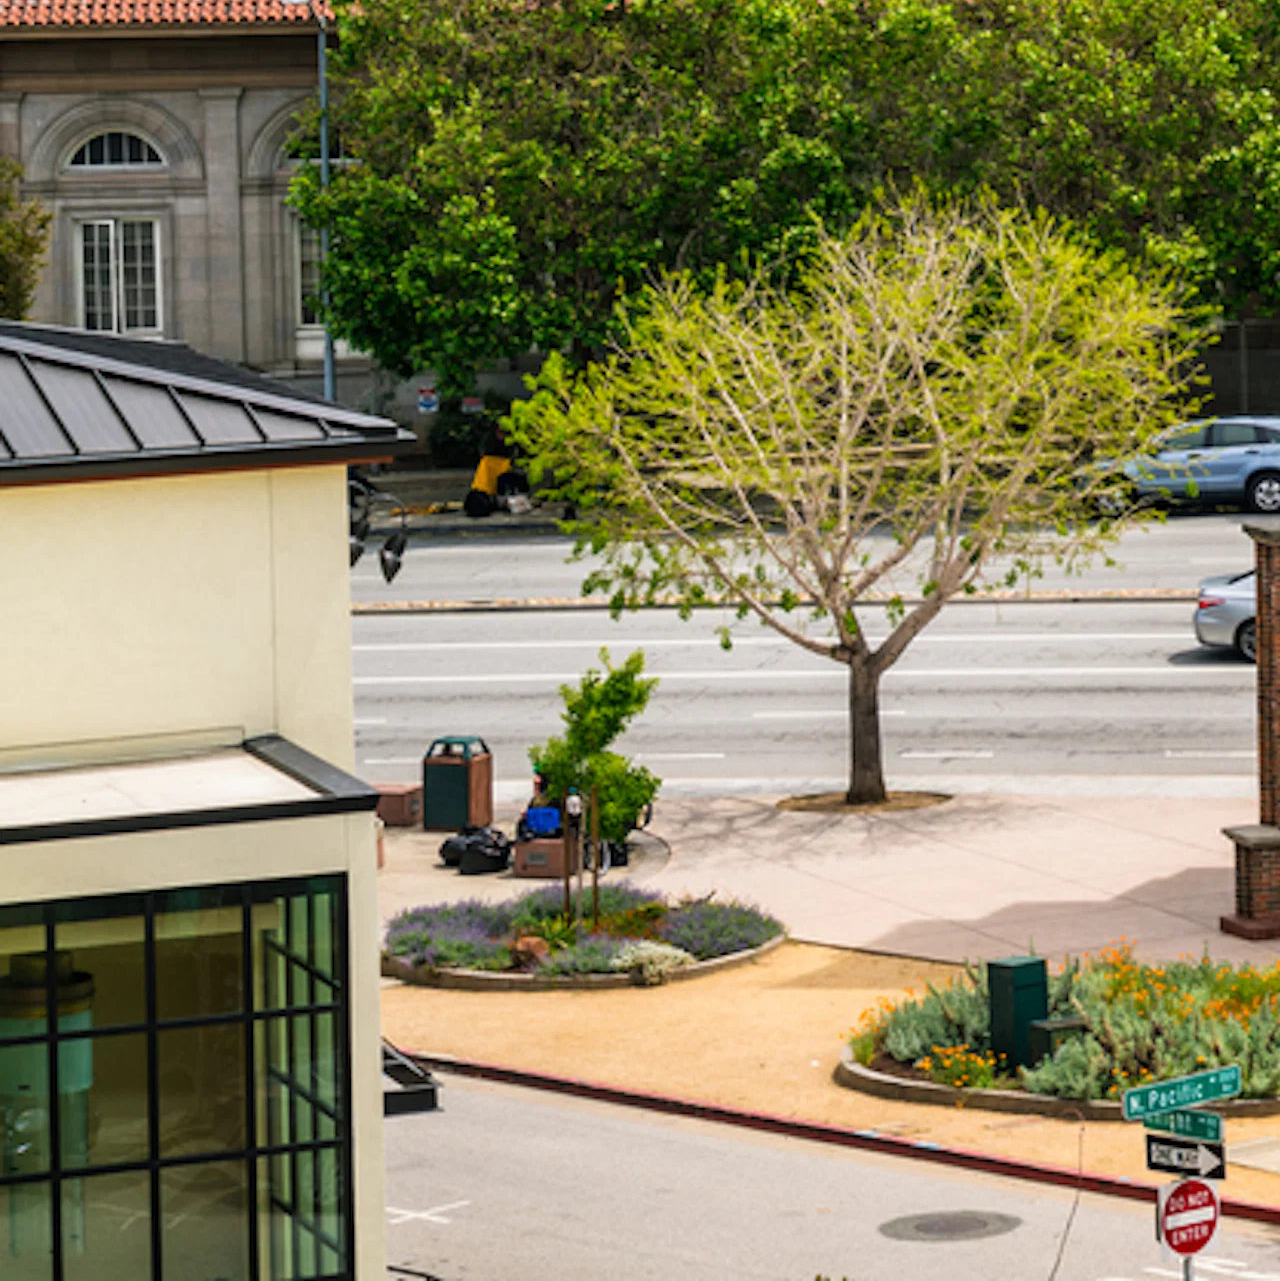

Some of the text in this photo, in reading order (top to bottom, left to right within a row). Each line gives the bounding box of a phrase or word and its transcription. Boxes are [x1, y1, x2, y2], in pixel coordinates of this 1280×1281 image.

[1148, 1081, 1204, 1111] Pacific
[1169, 1190, 1209, 1213] DO NOT
[1171, 1224, 1210, 1246] ENTER
